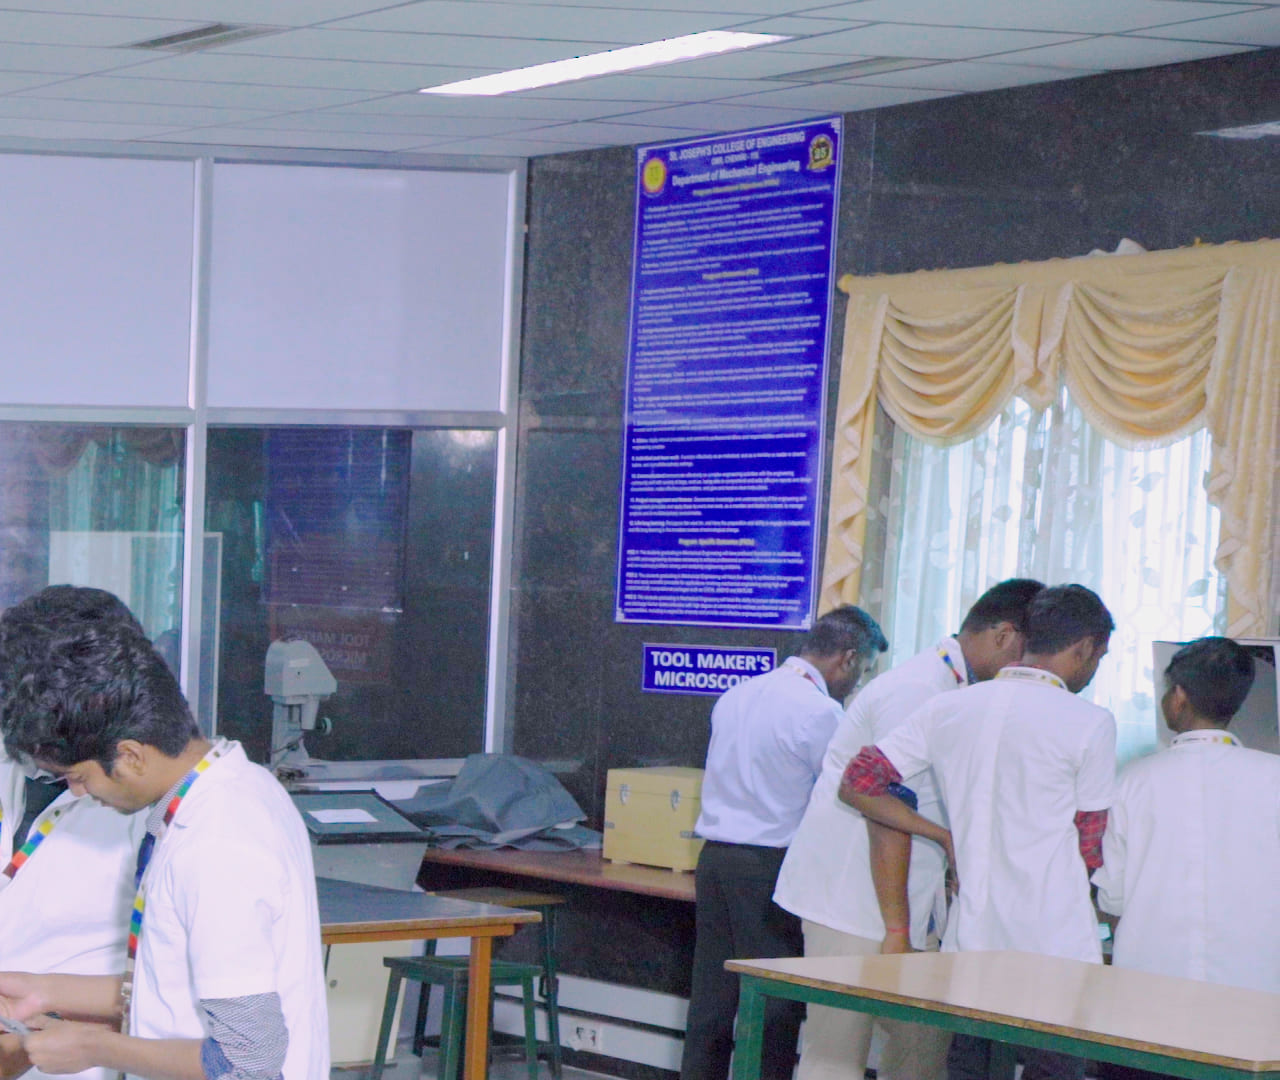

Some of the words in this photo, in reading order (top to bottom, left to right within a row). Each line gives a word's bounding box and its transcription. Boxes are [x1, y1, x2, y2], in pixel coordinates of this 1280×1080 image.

[712, 141, 745, 155] COLLEGE
[745, 138, 756, 150] OF
[756, 131, 805, 148] ENGINEERING
[672, 173, 710, 188] Department
[757, 160, 800, 176] Engineering
[650, 651, 693, 668] TOOL
[697, 653, 771, 672] MAKER'S
